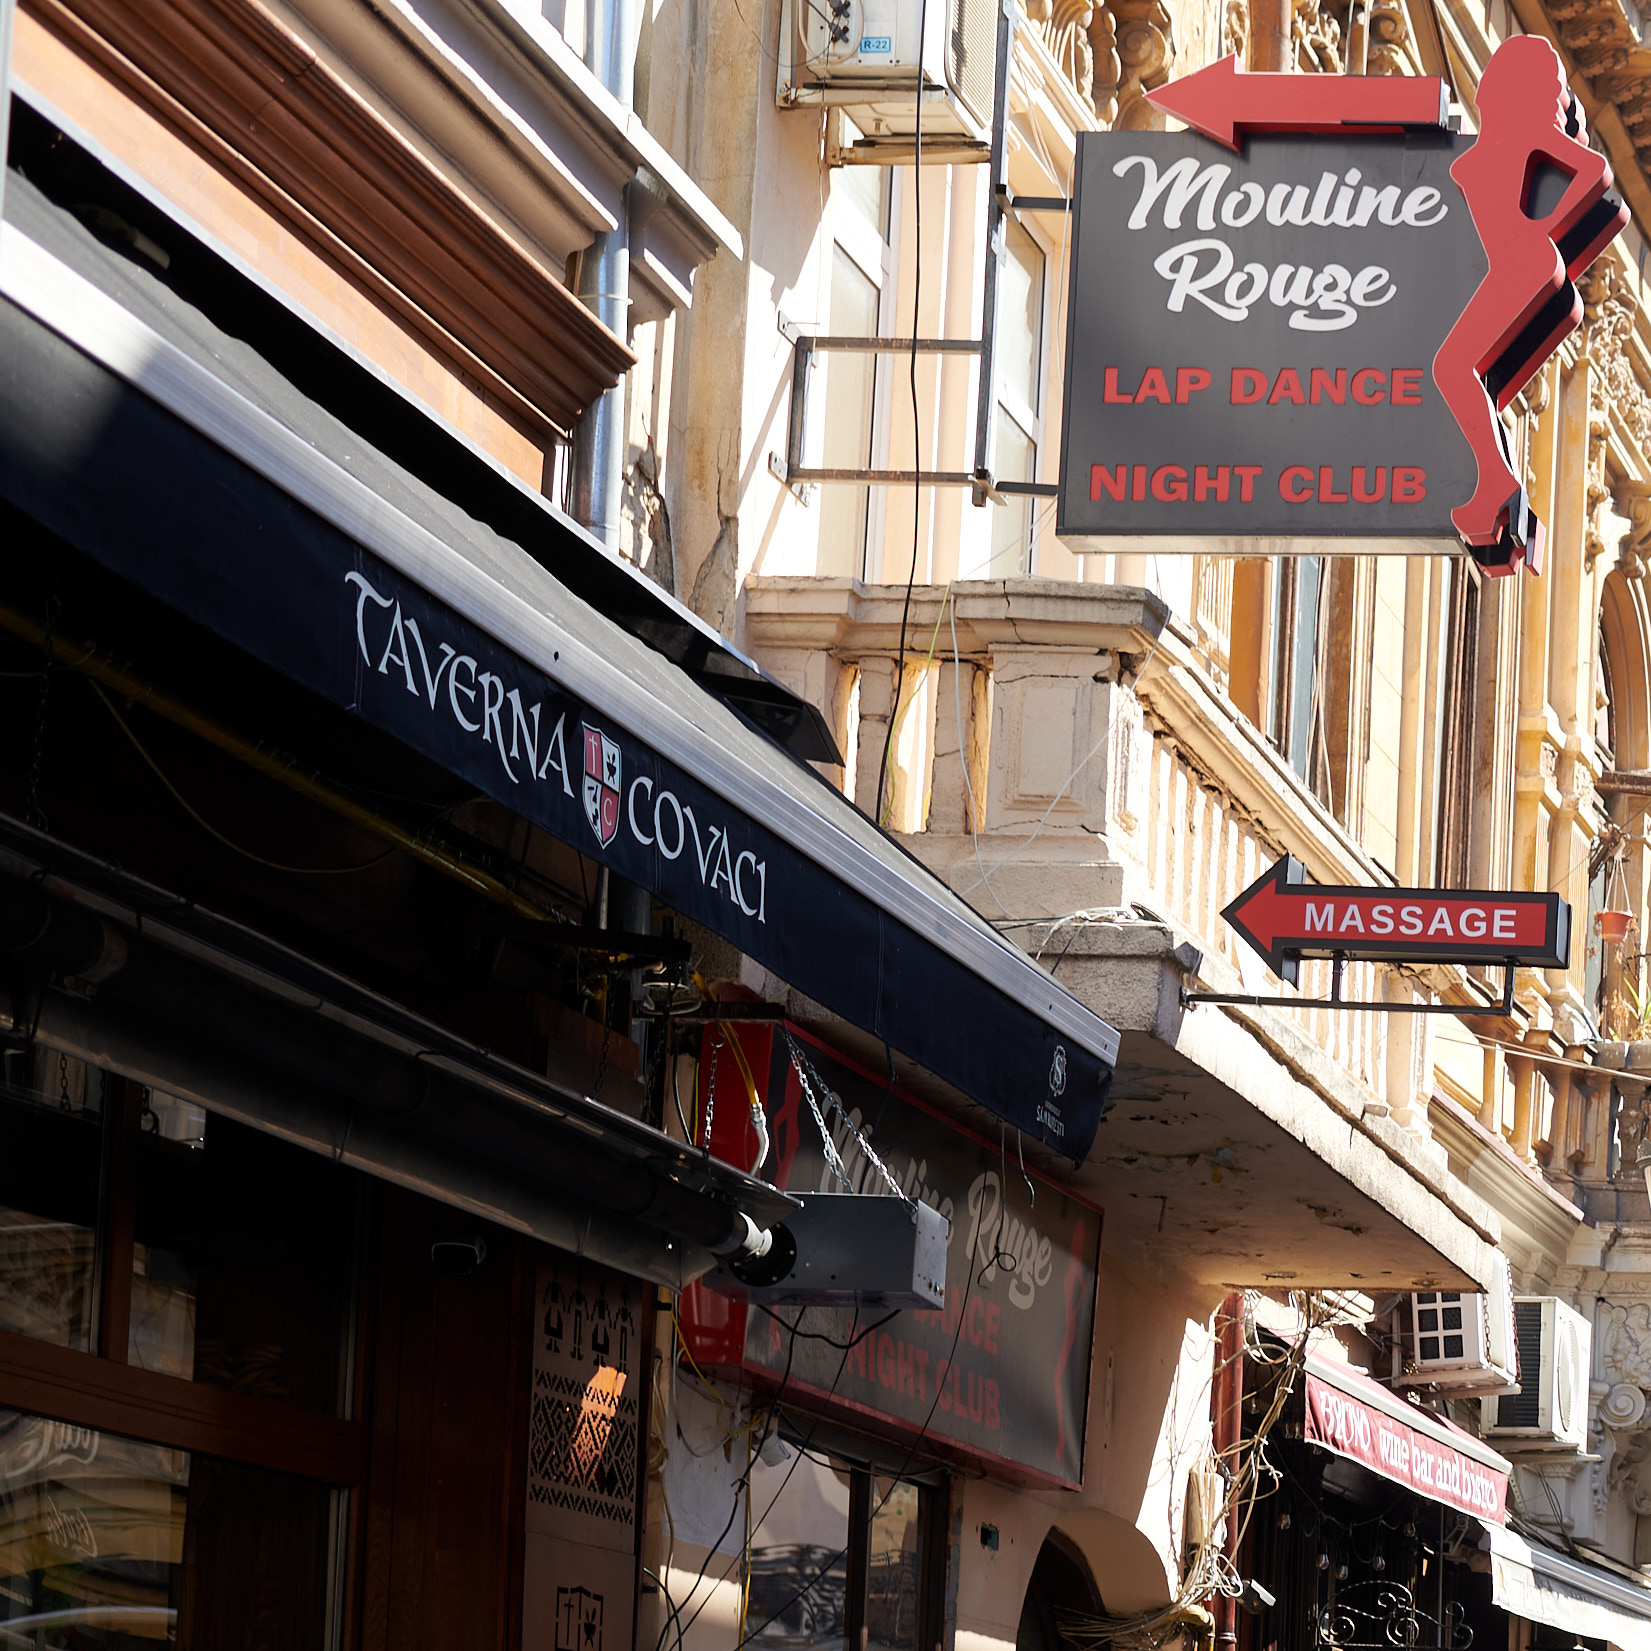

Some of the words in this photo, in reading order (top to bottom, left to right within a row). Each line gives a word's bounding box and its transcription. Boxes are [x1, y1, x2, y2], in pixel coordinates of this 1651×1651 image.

[864, 40, 888, 49] R-22
[1112, 155, 1448, 231] Mouline
[1153, 238, 1397, 332] Rouge
[1103, 367, 1212, 404] LAP
[1230, 367, 1423, 405] DANCE
[1089, 464, 1262, 502] NIGHT
[1278, 465, 1427, 504] CLUB
[345, 571, 575, 799] TAVERNA
[628, 776, 766, 924] COVACI
[1304, 902, 1519, 940] MASSAGE
[965, 1170, 1052, 1310] Rouge
[848, 1319, 929, 1402] NIGHT
[935, 1357, 1000, 1430] CLUB
[1319, 1391, 1371, 1453] BRUNO
[1378, 1425, 1410, 1472] wine
[1411, 1440, 1434, 1484] bar
[1435, 1453, 1461, 1494] and
[1461, 1463, 1498, 1512] bistro
